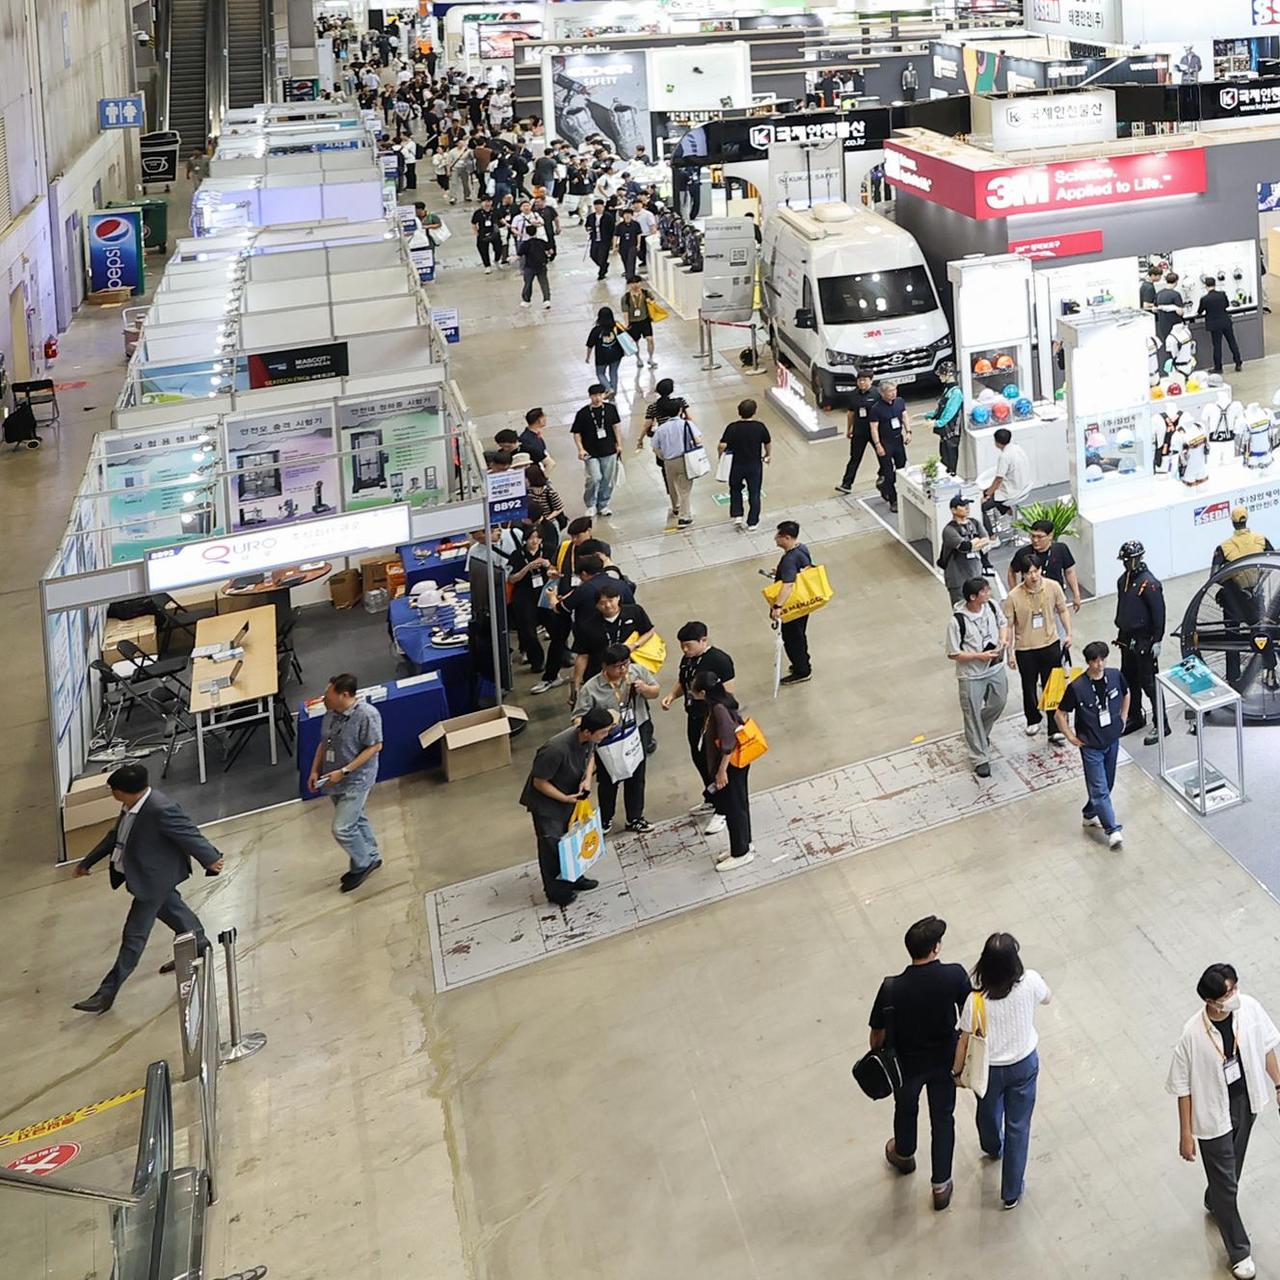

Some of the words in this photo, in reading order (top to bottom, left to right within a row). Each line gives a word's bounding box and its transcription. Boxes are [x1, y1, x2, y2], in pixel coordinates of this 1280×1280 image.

[584, 77, 618, 86] SAFETY
[1055, 167, 1118, 184] Science.
[985, 171, 1050, 210] 3M
[1055, 180, 1113, 202] Applied
[1116, 182, 1131, 194] to
[107, 246, 123, 289] pepsi
[864, 328, 883, 339] 3M
[408, 396, 432, 407] 시험기
[239, 426, 268, 437] 안전모
[294, 416, 323, 427] 시험기
